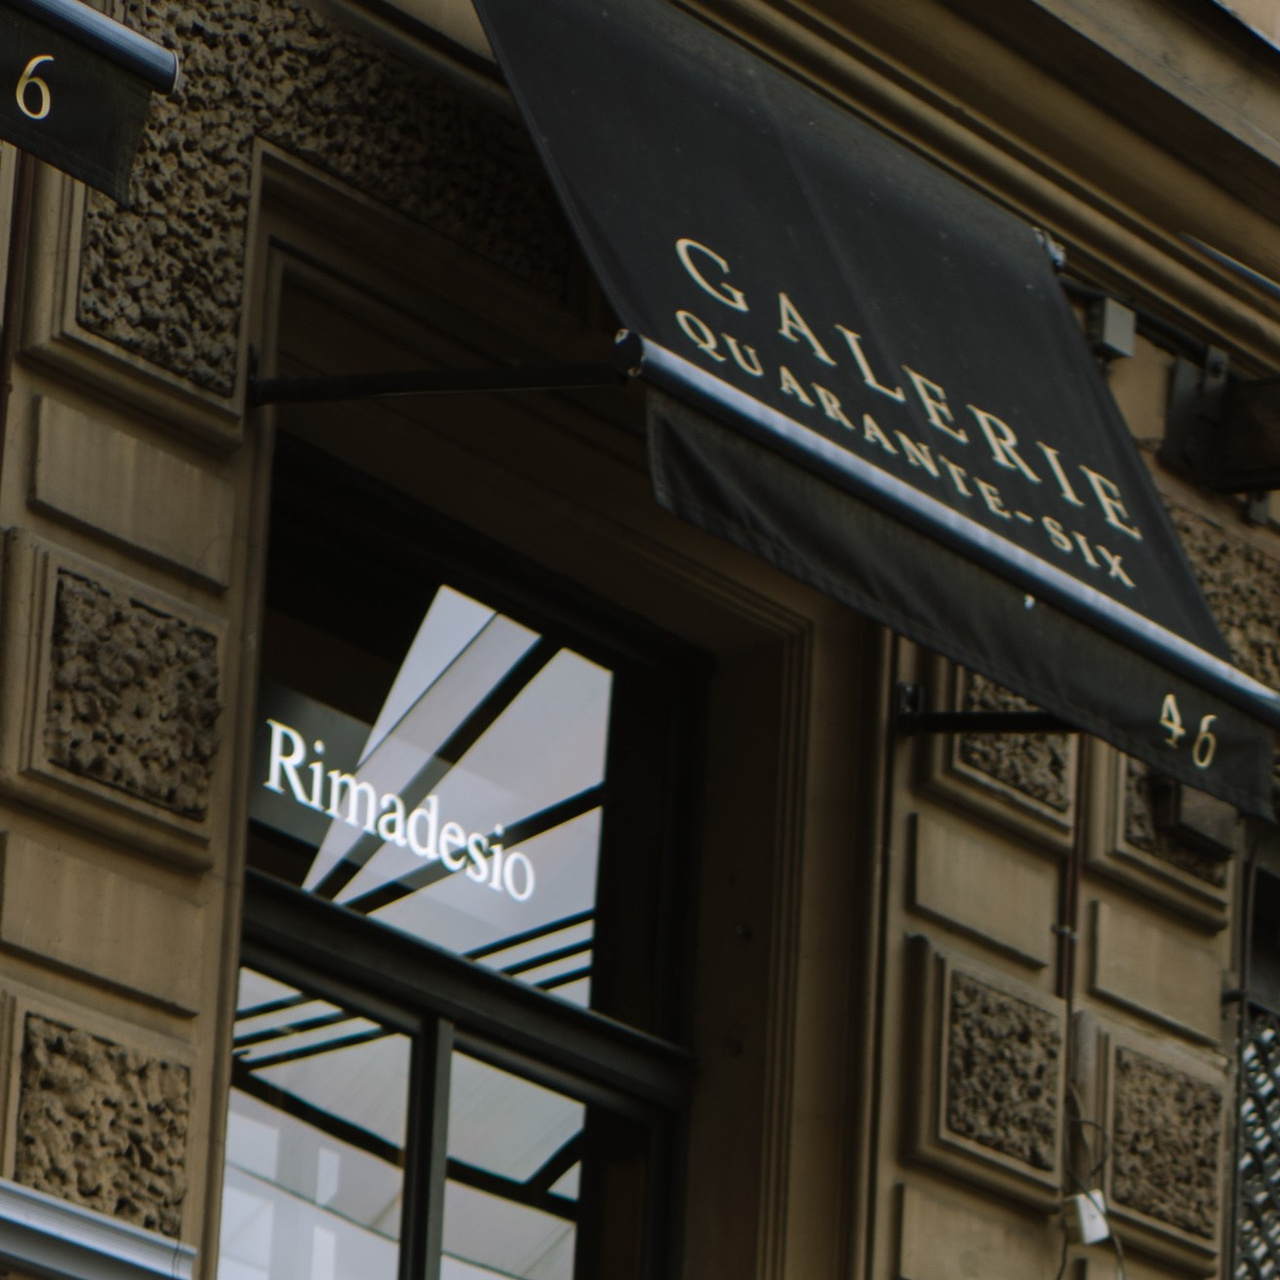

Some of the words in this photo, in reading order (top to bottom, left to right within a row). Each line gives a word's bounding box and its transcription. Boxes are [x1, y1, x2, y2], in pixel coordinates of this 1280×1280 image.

[16, 54, 54, 120] 6
[675, 238, 1142, 540] GALERIE
[675, 309, 1135, 588] QUARANTE-SIX
[263, 718, 535, 901] Rimadesio
[1158, 693, 1217, 768] 46
